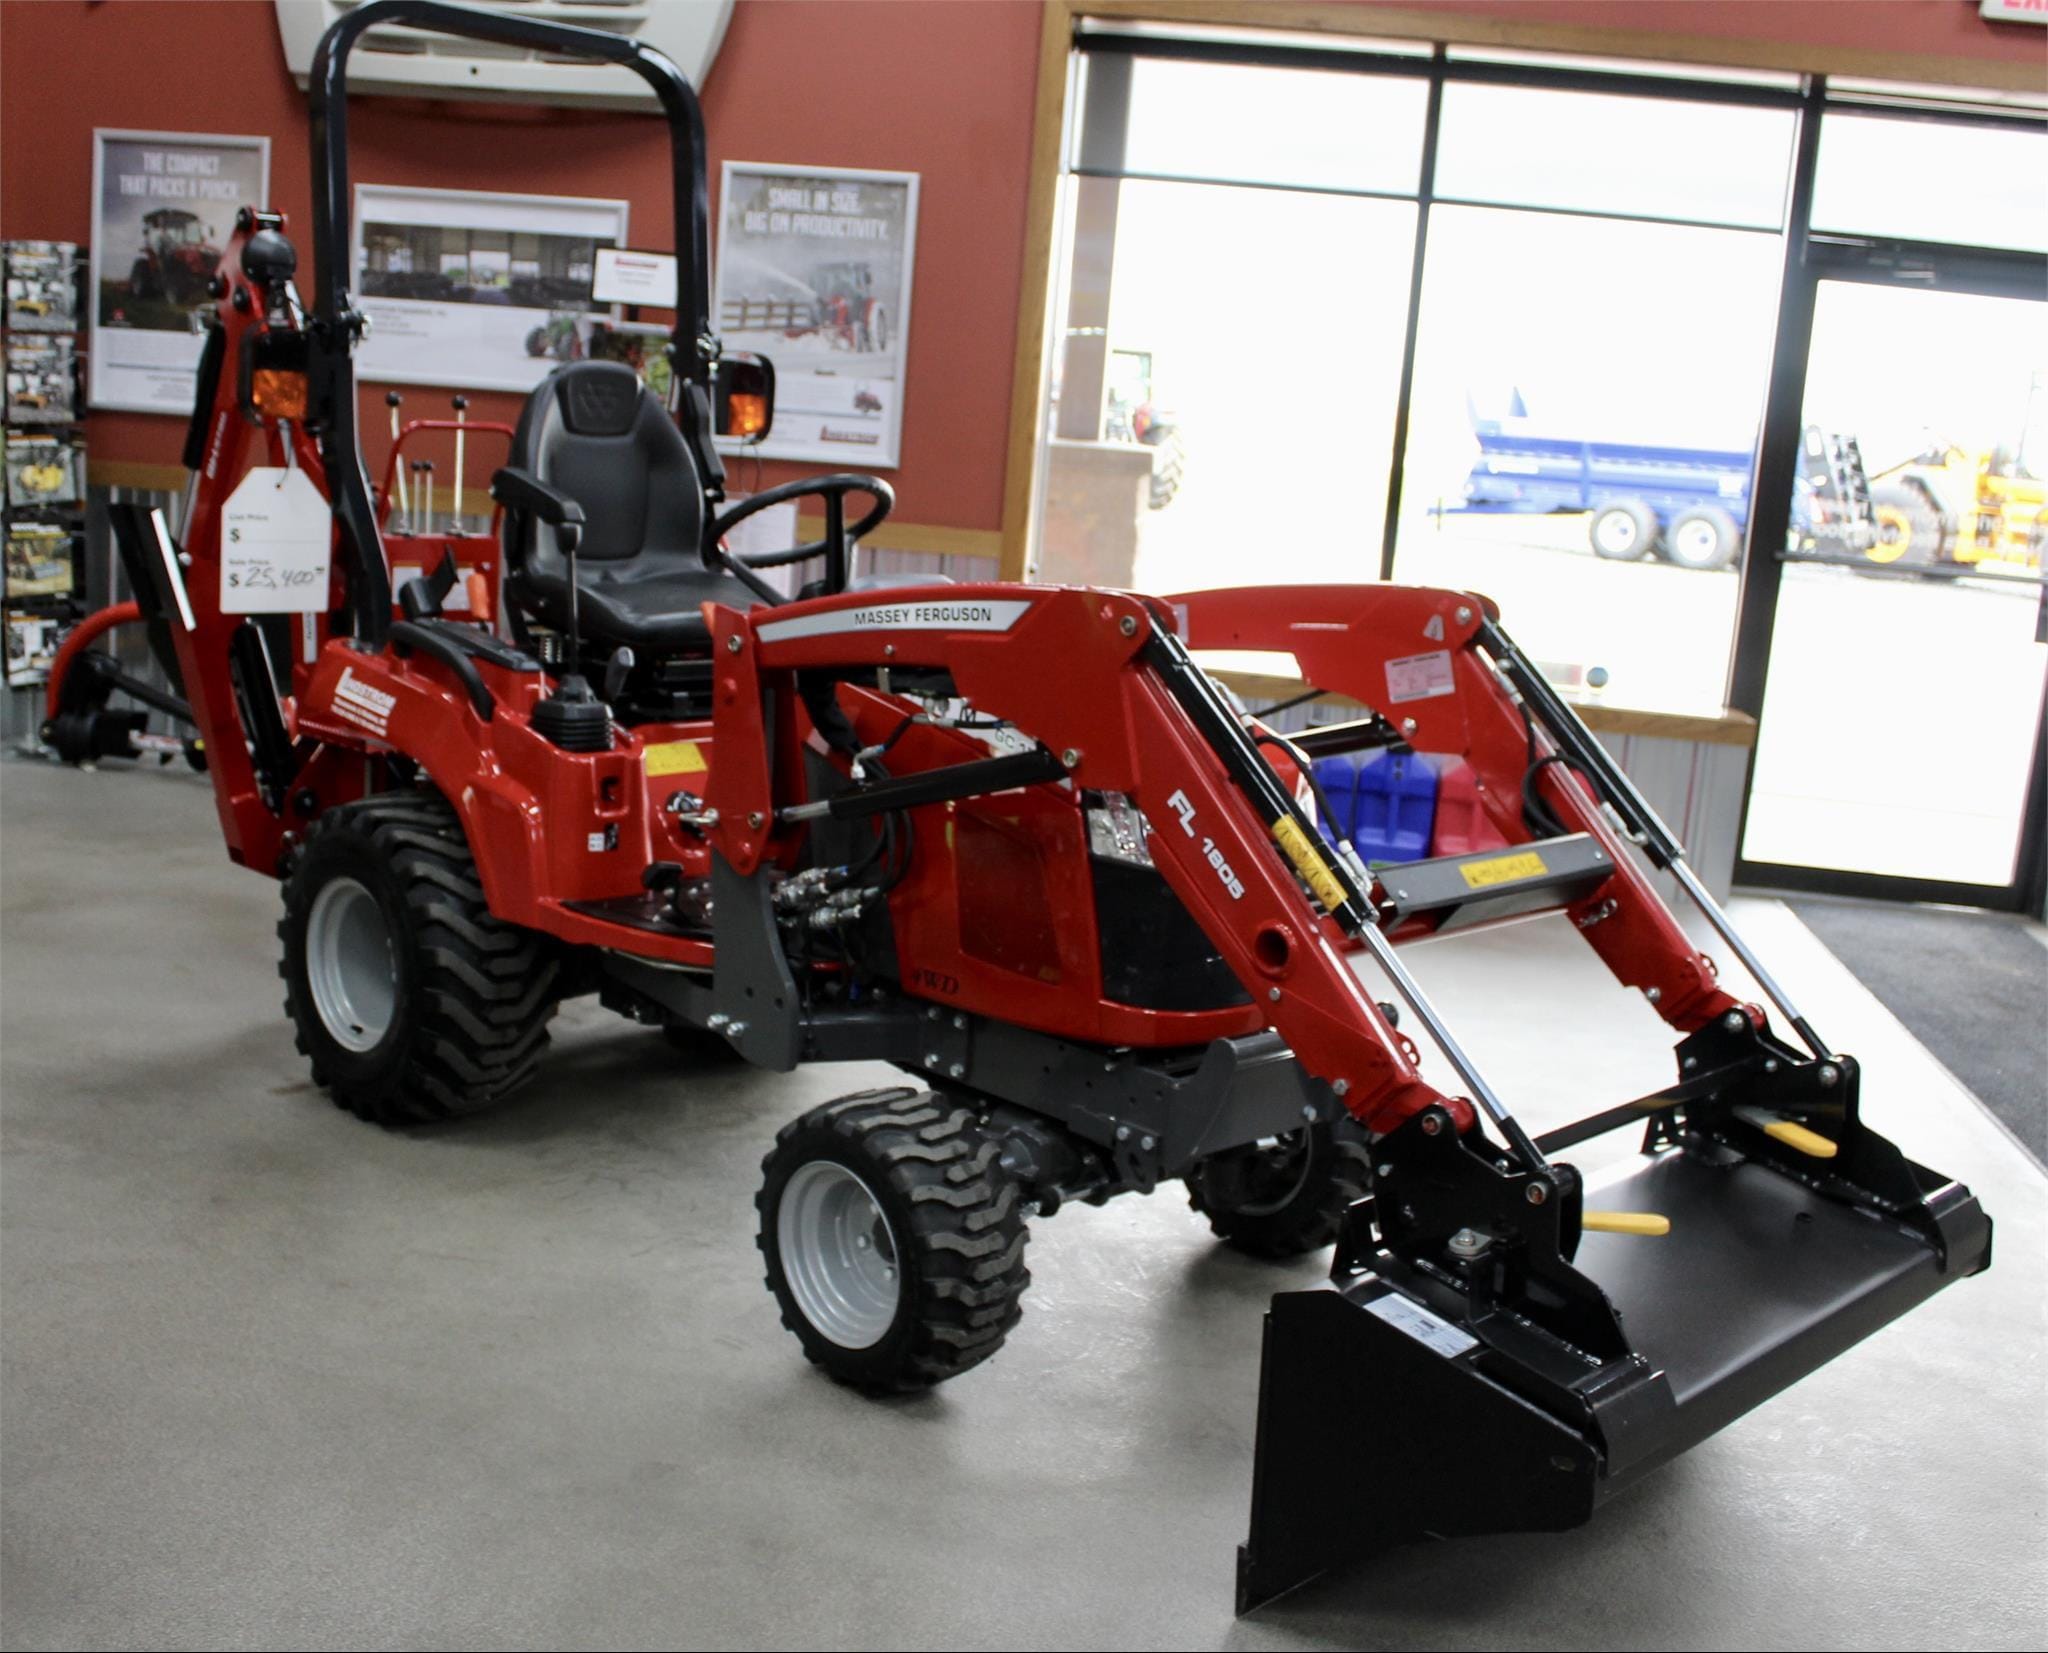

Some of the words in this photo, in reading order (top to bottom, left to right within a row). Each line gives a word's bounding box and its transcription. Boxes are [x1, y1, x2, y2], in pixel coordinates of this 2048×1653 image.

[143, 152, 163, 172] THE
[166, 153, 219, 175] COMPACT
[120, 174, 147, 196] THAT
[149, 176, 186, 198] PACKS
[188, 178, 197, 198] A
[814, 190, 828, 212] IN
[229, 527, 240, 543] $
[229, 572, 240, 588] $
[854, 608, 909, 625] MASSEY
[915, 607, 992, 622] FERGUSON
[1166, 788, 1196, 839] FL
[1202, 836, 1245, 900] 1805
